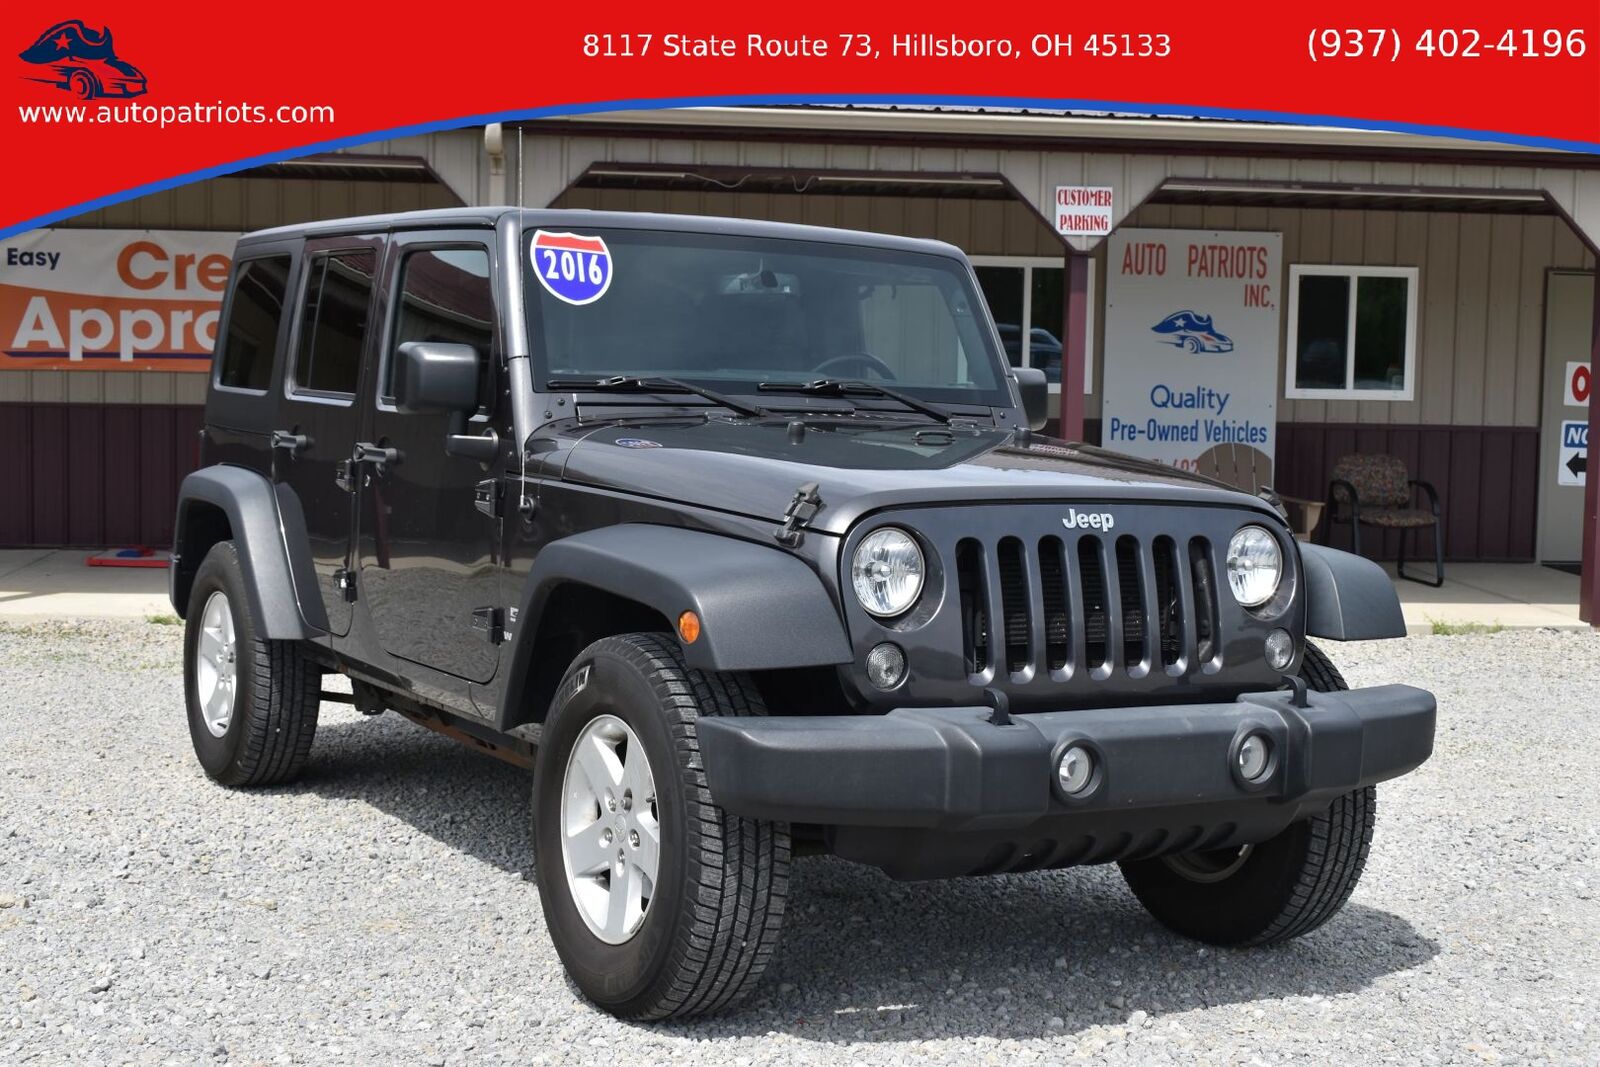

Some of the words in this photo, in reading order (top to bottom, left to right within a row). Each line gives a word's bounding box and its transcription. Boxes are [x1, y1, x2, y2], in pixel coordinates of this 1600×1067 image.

[1057, 188, 1112, 207] CUSTOMER
[1060, 214, 1108, 231] PARKING
[7, 248, 61, 270] Easy
[117, 240, 233, 292] Cre
[543, 249, 603, 286] 2016
[1121, 243, 1167, 276] AUTO
[1187, 244, 1269, 279] PATRIOTS
[1244, 284, 1275, 308] INC.
[1150, 384, 1230, 416] Quality
[1110, 417, 1199, 442] Pre-Owned
[1204, 419, 1268, 443] Vehicles
[1062, 508, 1114, 533] Jeep
